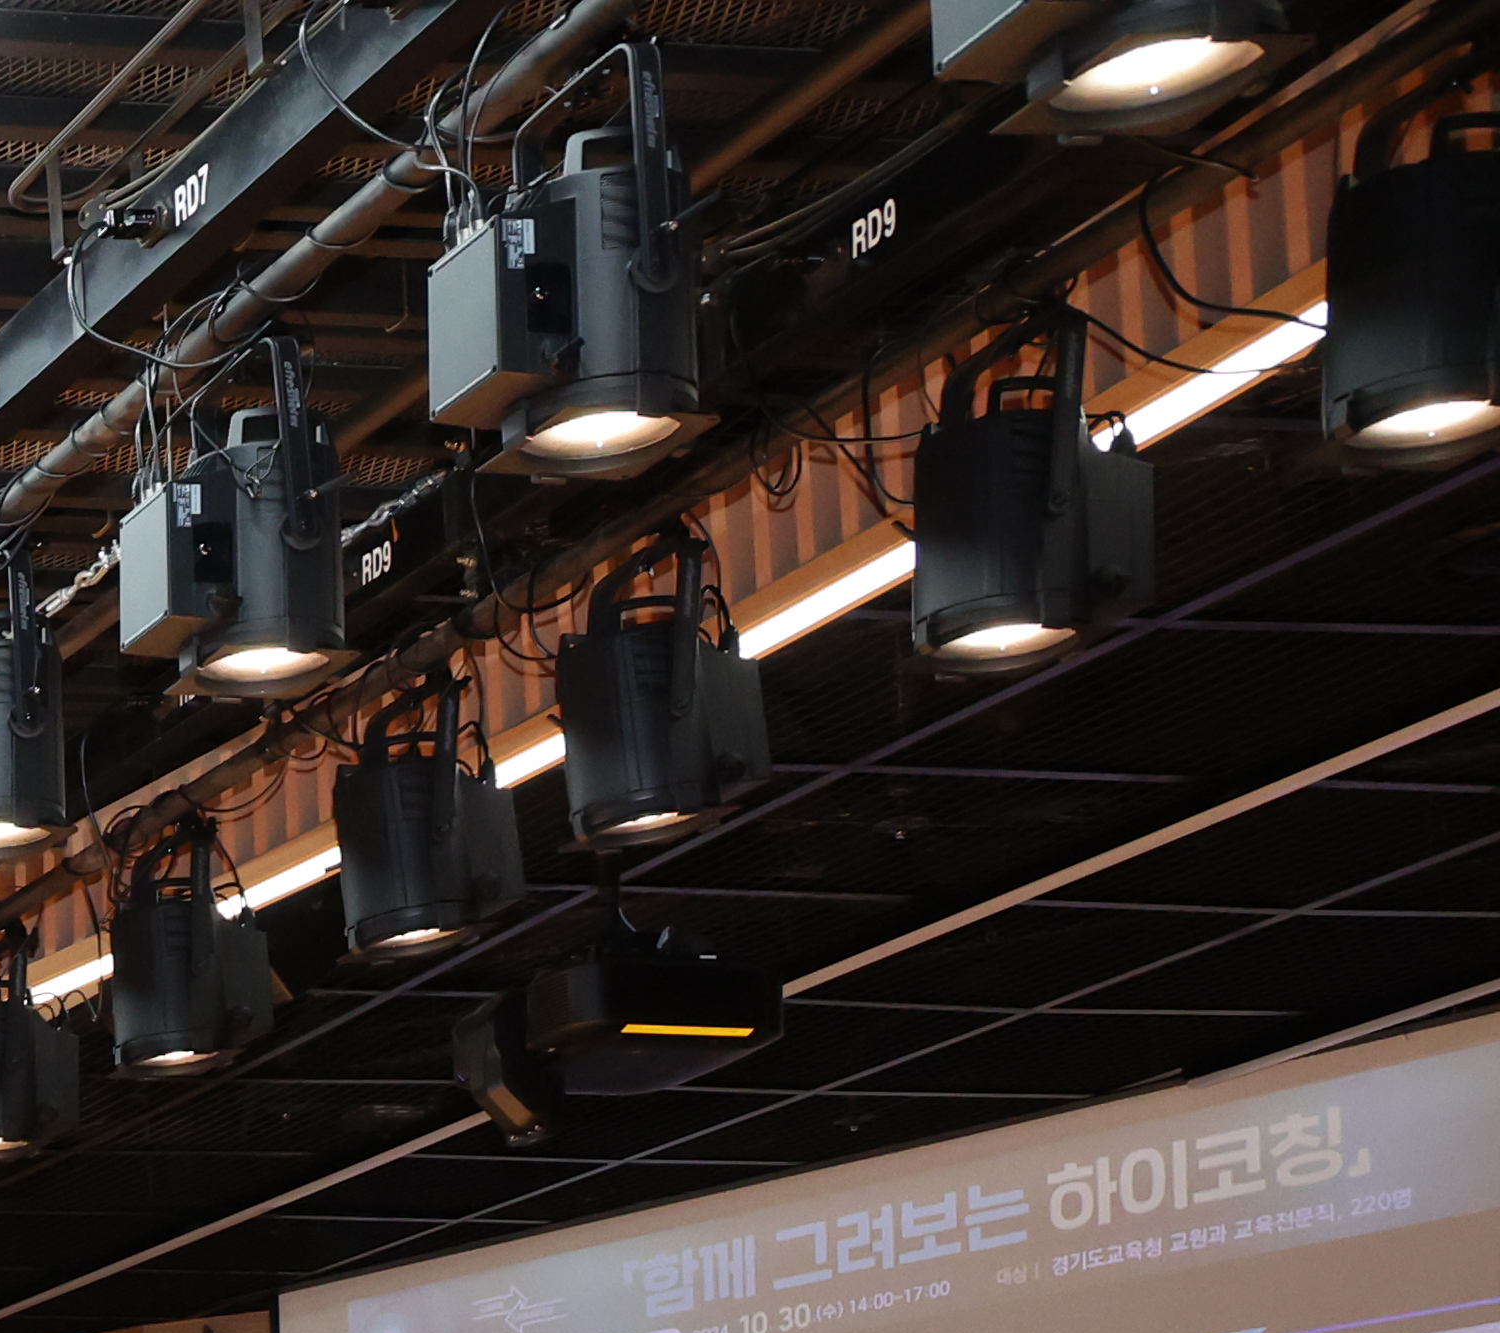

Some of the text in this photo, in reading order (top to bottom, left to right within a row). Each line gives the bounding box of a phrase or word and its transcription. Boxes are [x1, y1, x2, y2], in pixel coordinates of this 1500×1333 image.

[174, 162, 210, 227] RD7
[852, 198, 897, 259] RD9
[361, 541, 393, 585] RD9
[773, 1185, 1029, 1290] 그려보는
[1051, 1236, 1163, 1278] 경기도교육청
[1169, 1228, 1228, 1253] 교원과
[1350, 1188, 1412, 1217] 220명
